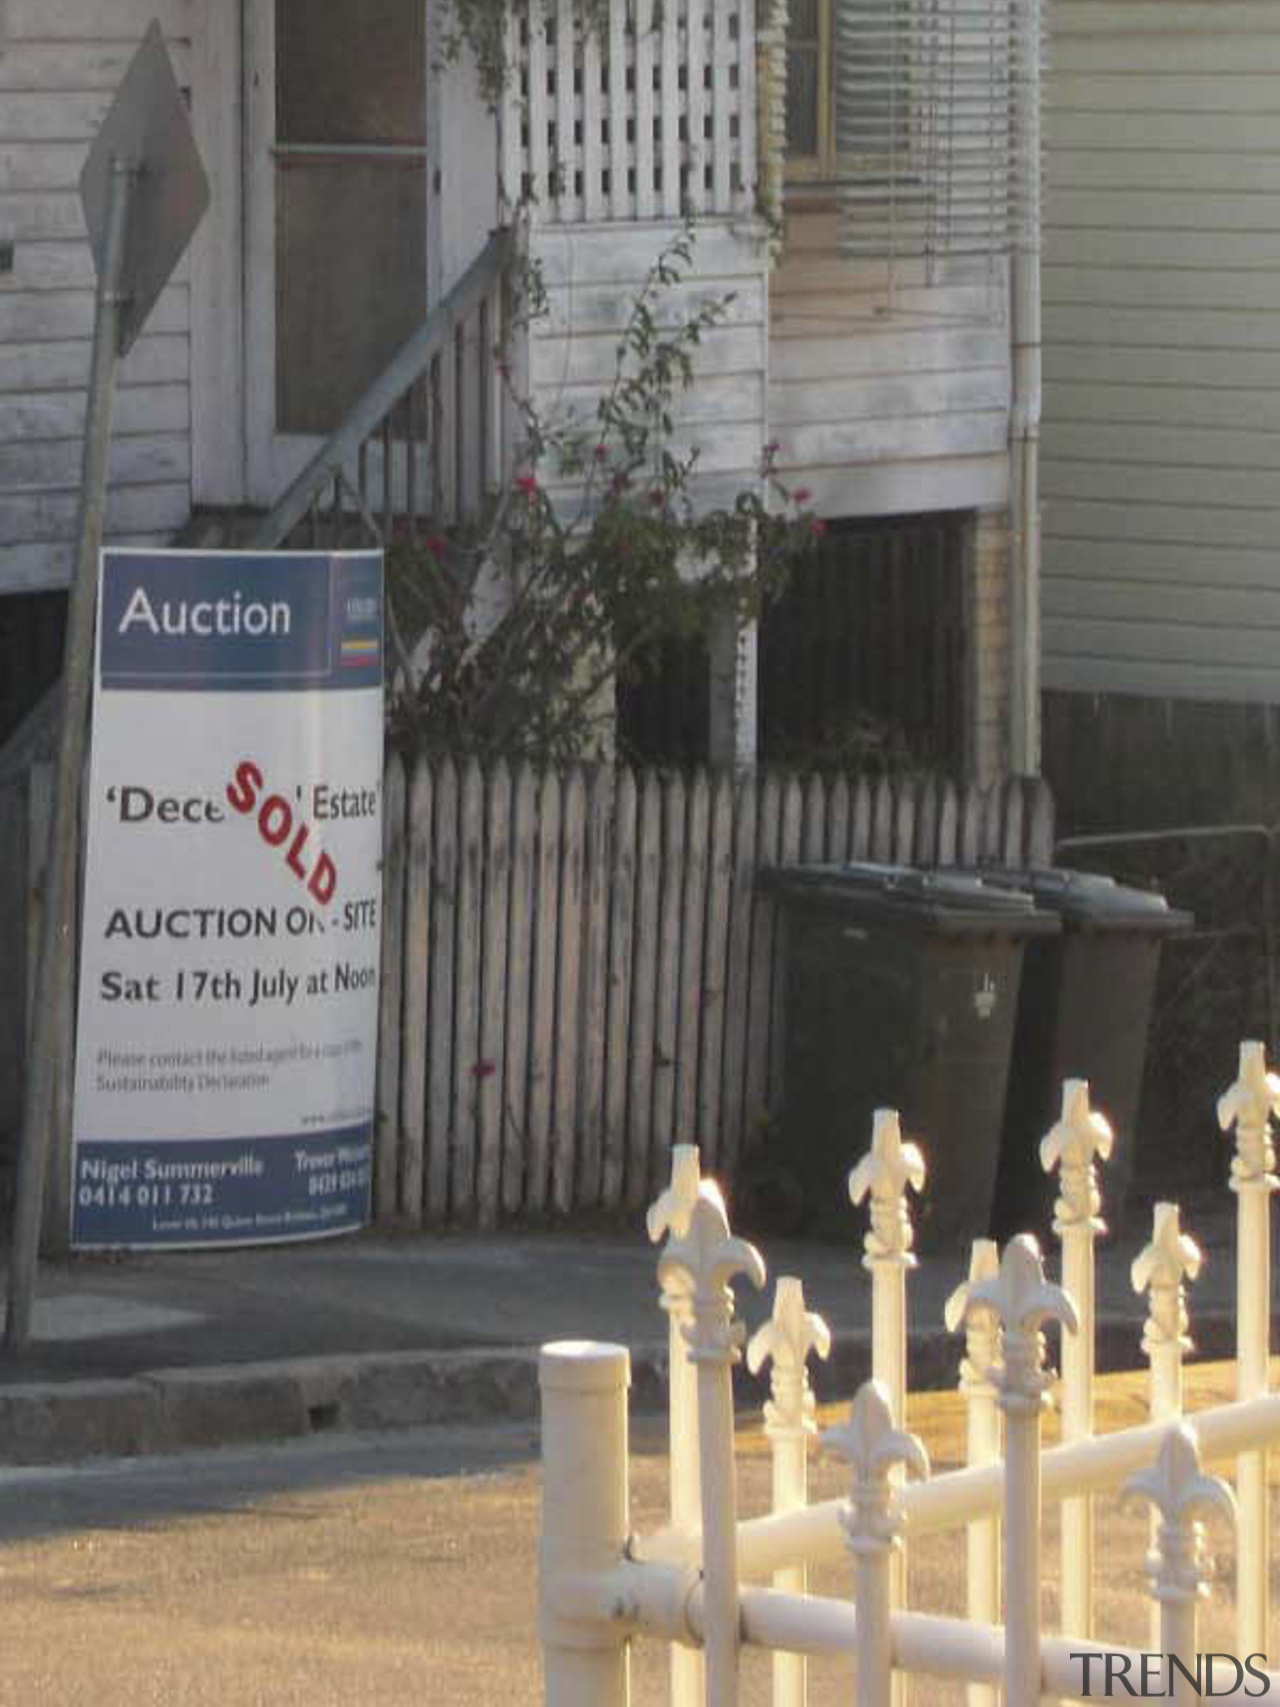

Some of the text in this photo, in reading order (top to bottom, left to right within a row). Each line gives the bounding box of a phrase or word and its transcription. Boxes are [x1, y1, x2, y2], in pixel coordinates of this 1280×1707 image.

[119, 587, 291, 635] Auction
[226, 761, 337, 906] SOLD
[104, 907, 276, 940] AUCTION
[100, 970, 160, 1002] Sat
[176, 969, 241, 1001] 17th
[249, 967, 299, 1006] July
[307, 970, 328, 994] at
[81, 1152, 264, 1183] Nigel Summerville
[79, 1184, 131, 1207] 0414
